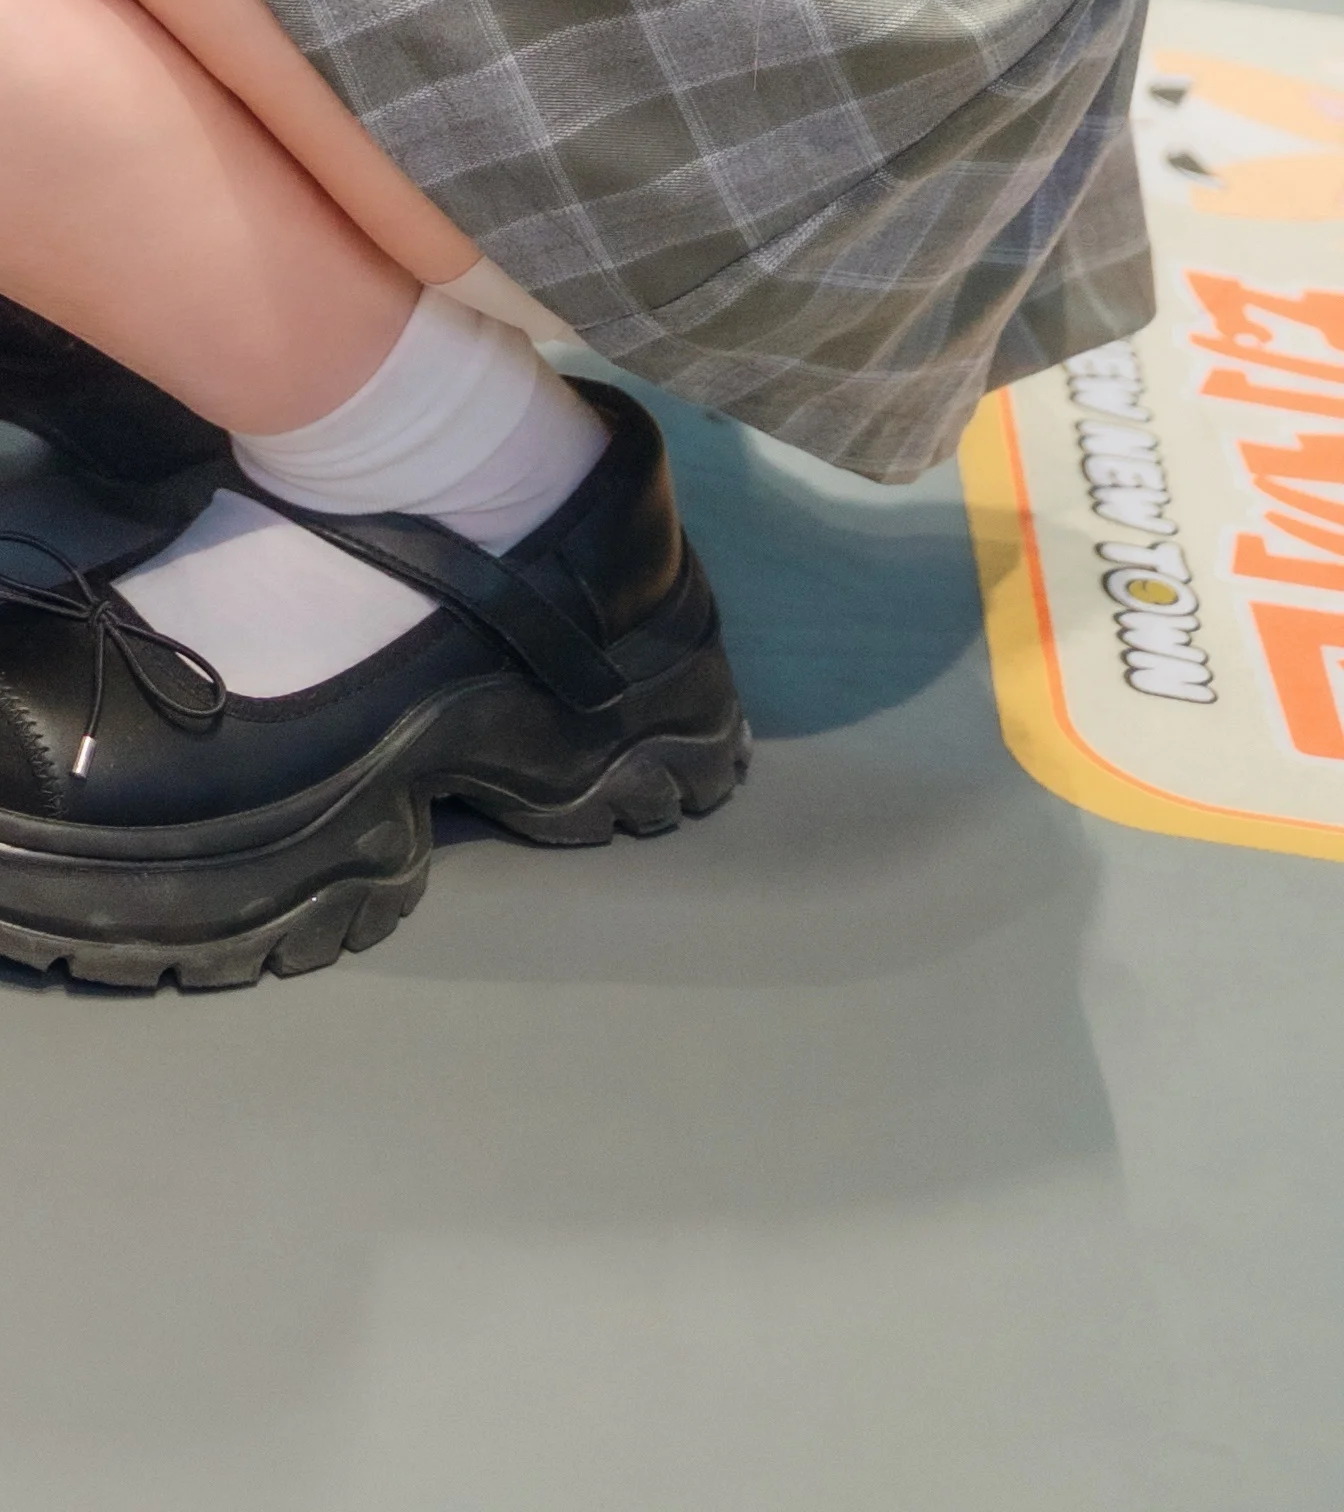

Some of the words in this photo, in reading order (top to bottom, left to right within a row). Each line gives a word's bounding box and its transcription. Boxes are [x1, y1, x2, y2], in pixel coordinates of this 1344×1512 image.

[1065, 339, 1153, 423] EW
[1076, 419, 1180, 537] NEW
[1095, 540, 1219, 705] TOWN
